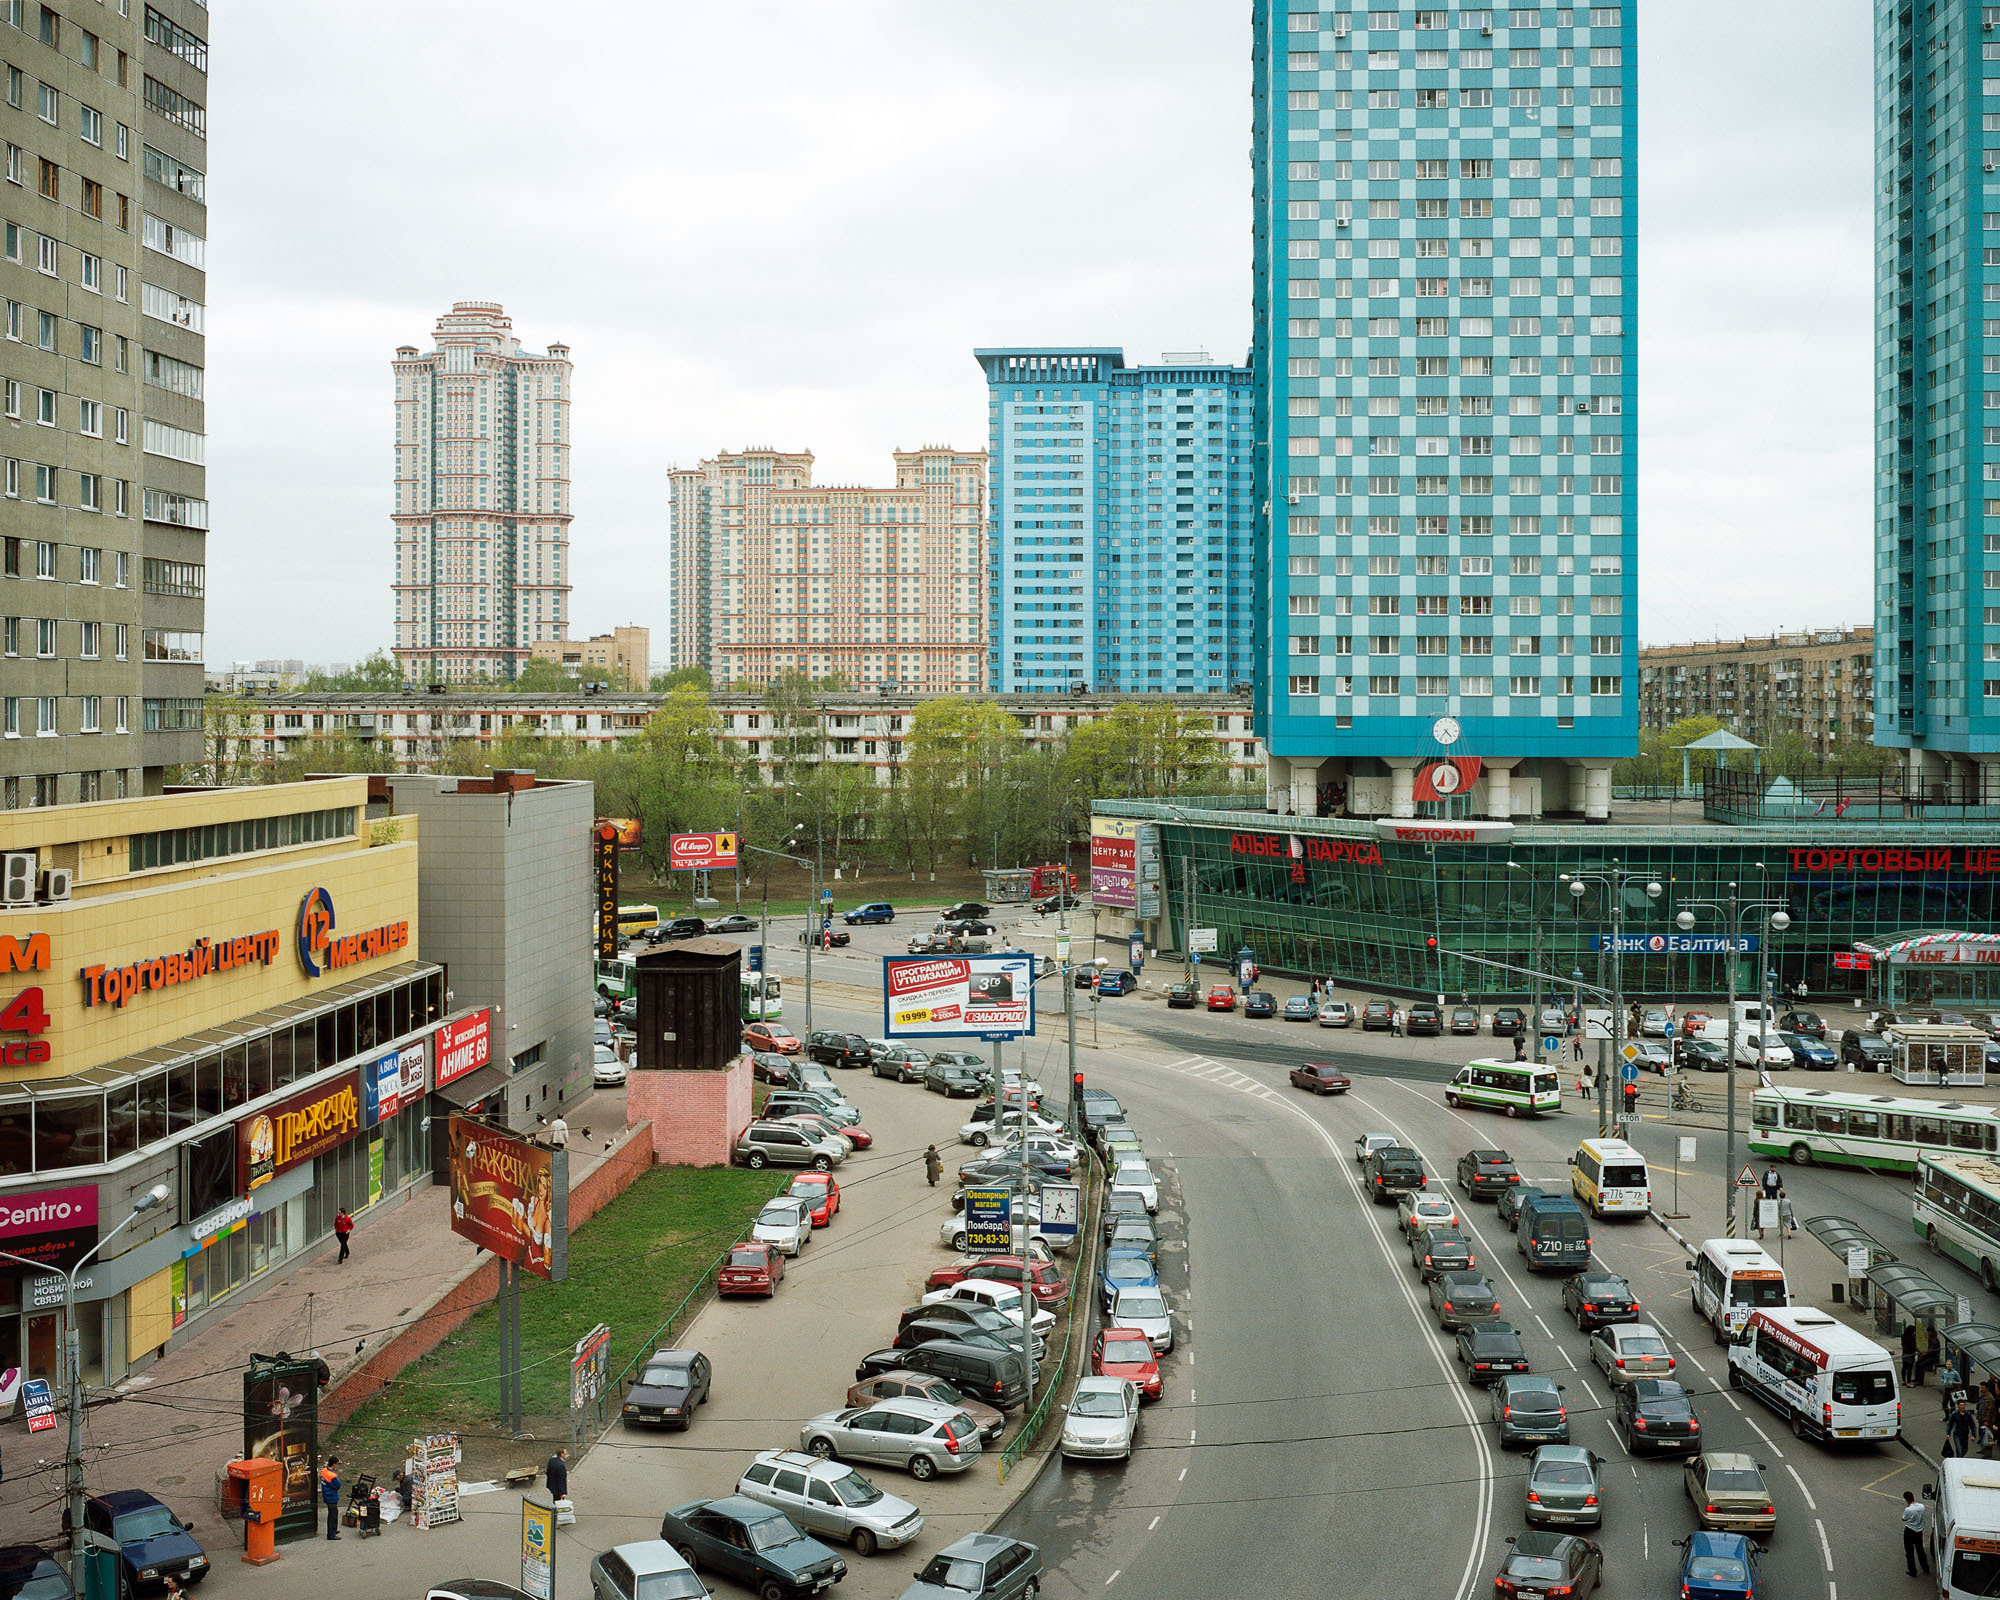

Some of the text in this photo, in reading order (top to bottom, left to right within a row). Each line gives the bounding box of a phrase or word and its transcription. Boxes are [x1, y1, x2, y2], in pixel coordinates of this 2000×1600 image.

[1395, 827, 1475, 842] РЕСТОРАН
[1093, 846, 1117, 857] ЦЕНТР
[1231, 834, 1383, 866] АЛЫЕ ПАРУСА
[1787, 845, 1952, 872] ТОРГОВЫЙ
[1291, 863, 1304, 877] 24
[602, 844, 614, 954] ЯКИТОРИЯ
[309, 911, 330, 952] 12
[328, 920, 409, 970] месяцев
[1906, 950, 1948, 963] АЛЫЕ
[80, 929, 280, 1008] Торговый центр
[896, 961, 955, 979] ПРОГРАММА
[897, 966, 962, 986] УТИЛИЗАЦИИ
[379, 1057, 398, 1074] АВИА
[440, 1042, 475, 1080] АНИМЕ
[476, 1036, 487, 1061] 69
[967, 1190, 1009, 1200] Ювелирный
[191, 1197, 254, 1240] СВЯЗНОЙ
[967, 1220, 1003, 1232] Ломбард
[968, 1234, 1009, 1244] 730-83-30
[33, 1278, 93, 1297] МОБИЛНОЙ
[34, 1274, 64, 1287] ЦЕНТР
[34, 1293, 64, 1306] СВЯЗИ
[1763, 1319, 1776, 1336] Вас
[1775, 1328, 1802, 1353] отекают
[1801, 1346, 1821, 1364] ноги?
